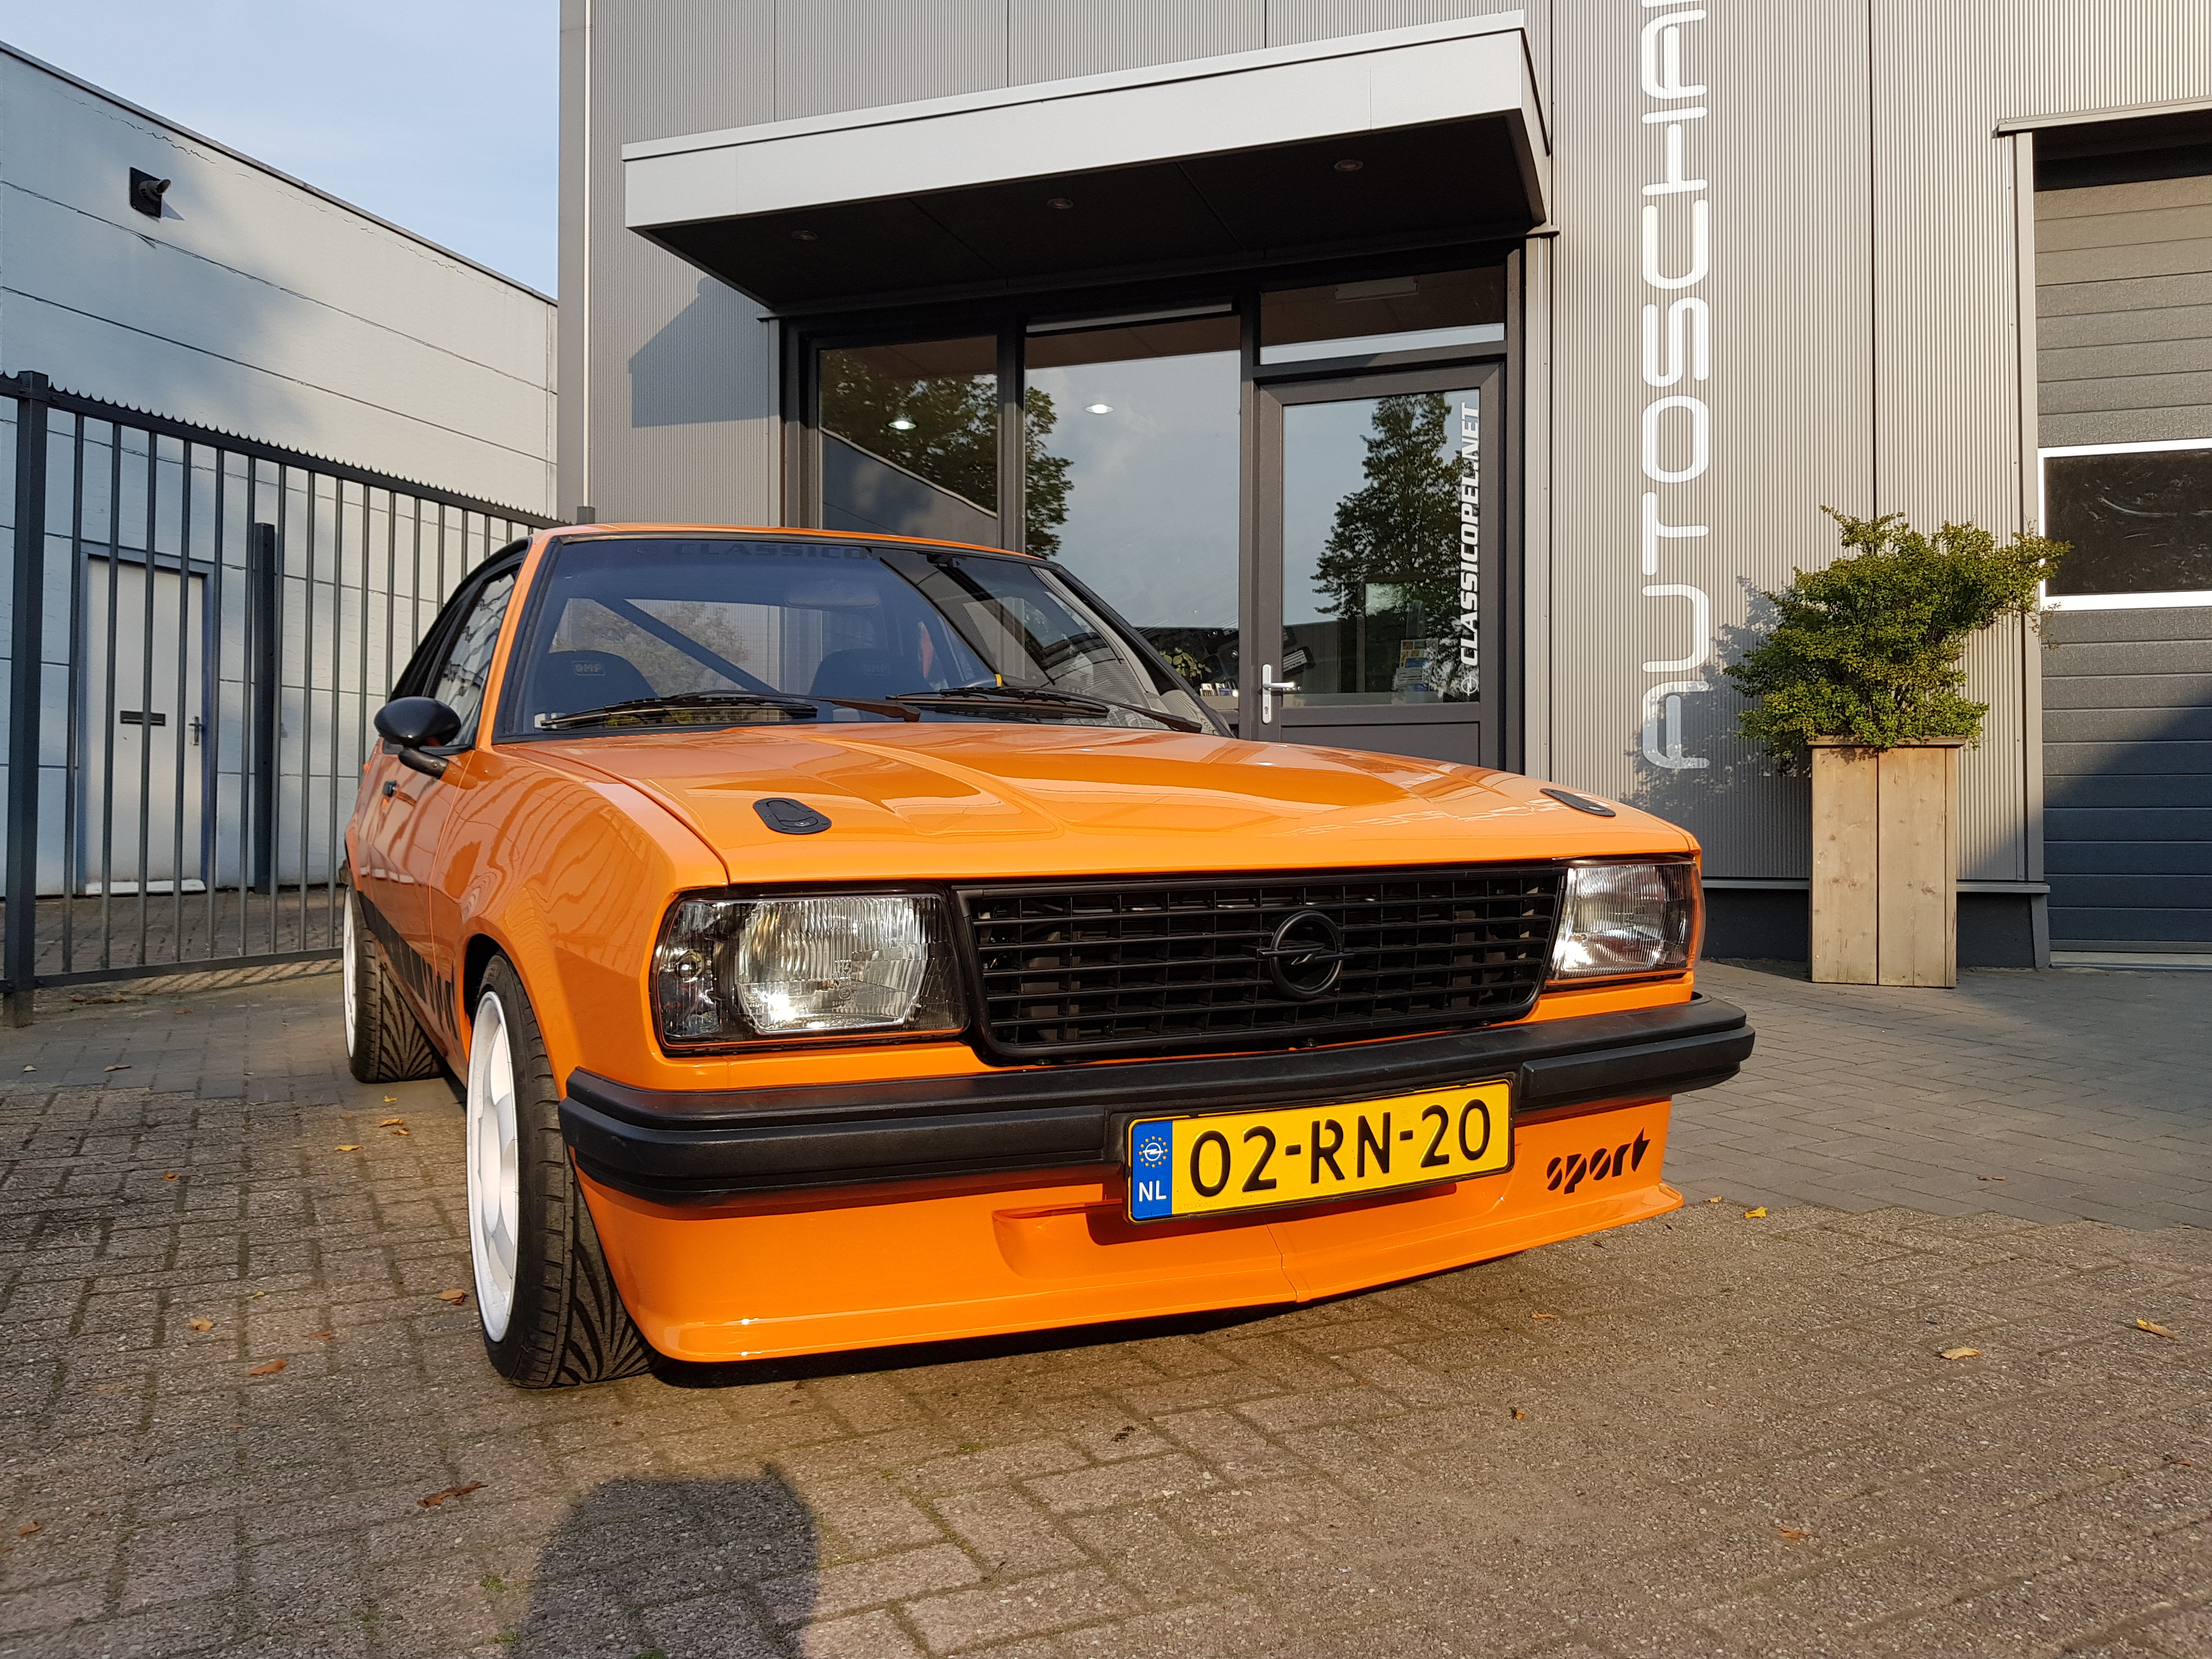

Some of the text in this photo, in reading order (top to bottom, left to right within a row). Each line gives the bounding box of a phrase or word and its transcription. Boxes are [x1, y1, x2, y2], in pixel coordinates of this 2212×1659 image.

[1640, 0, 1709, 769] AUTOSCHA
[1461, 402, 1479, 666] CLASSICOPEL.NET
[1138, 1180, 1167, 1202] NL
[1189, 1099, 1491, 1198] 02-RN-20
[1547, 1127, 1651, 1194] sport
